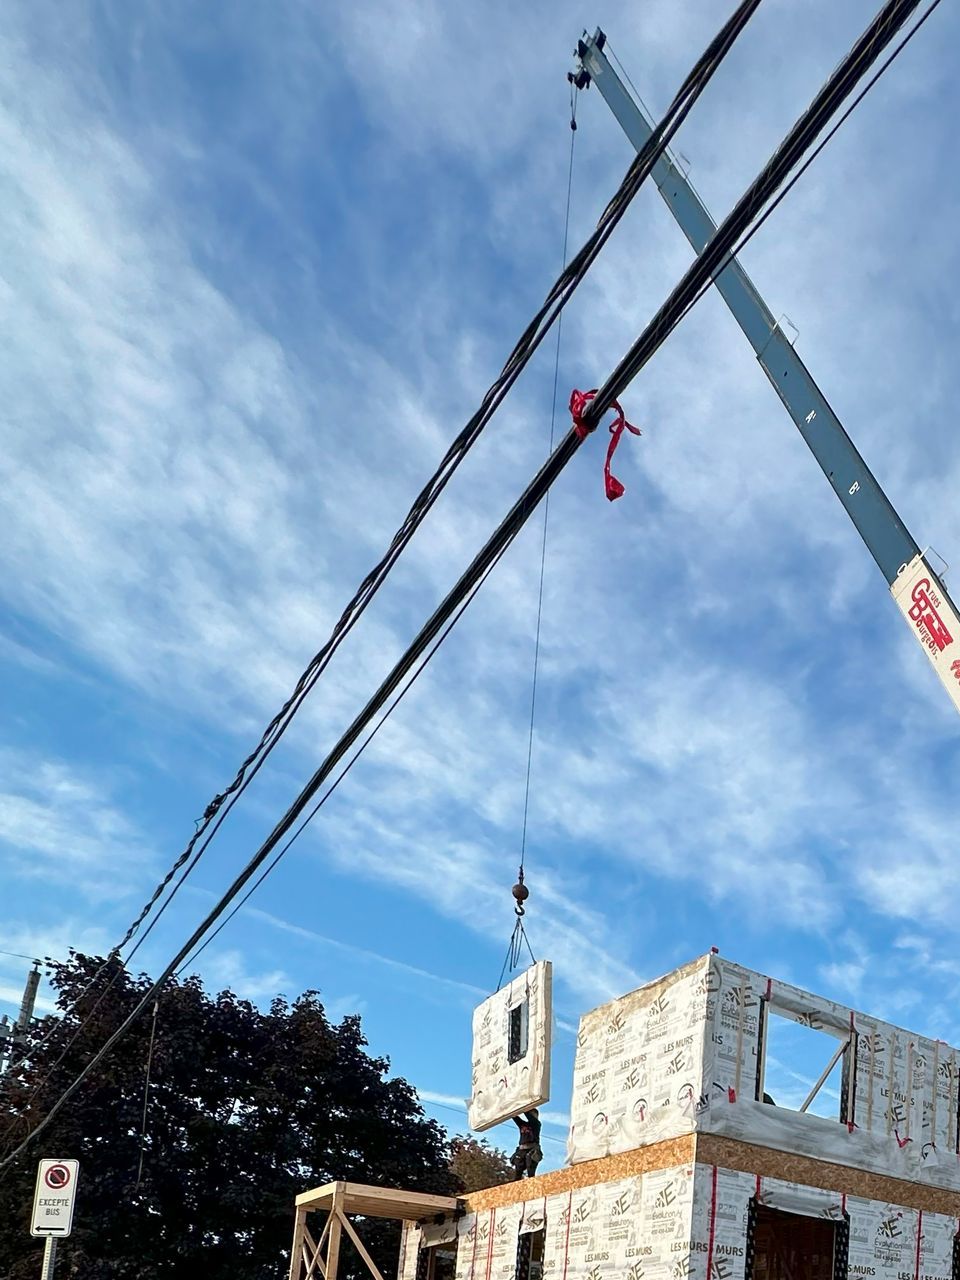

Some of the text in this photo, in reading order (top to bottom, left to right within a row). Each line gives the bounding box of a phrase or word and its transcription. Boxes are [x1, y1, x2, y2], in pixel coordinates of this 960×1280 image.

[46, 1208, 60, 1216] BUS
[671, 1242, 682, 1252] LES
[716, 1244, 744, 1257] MURS
[854, 1265, 876, 1276] MURS
[898, 1271, 911, 1280] LES
